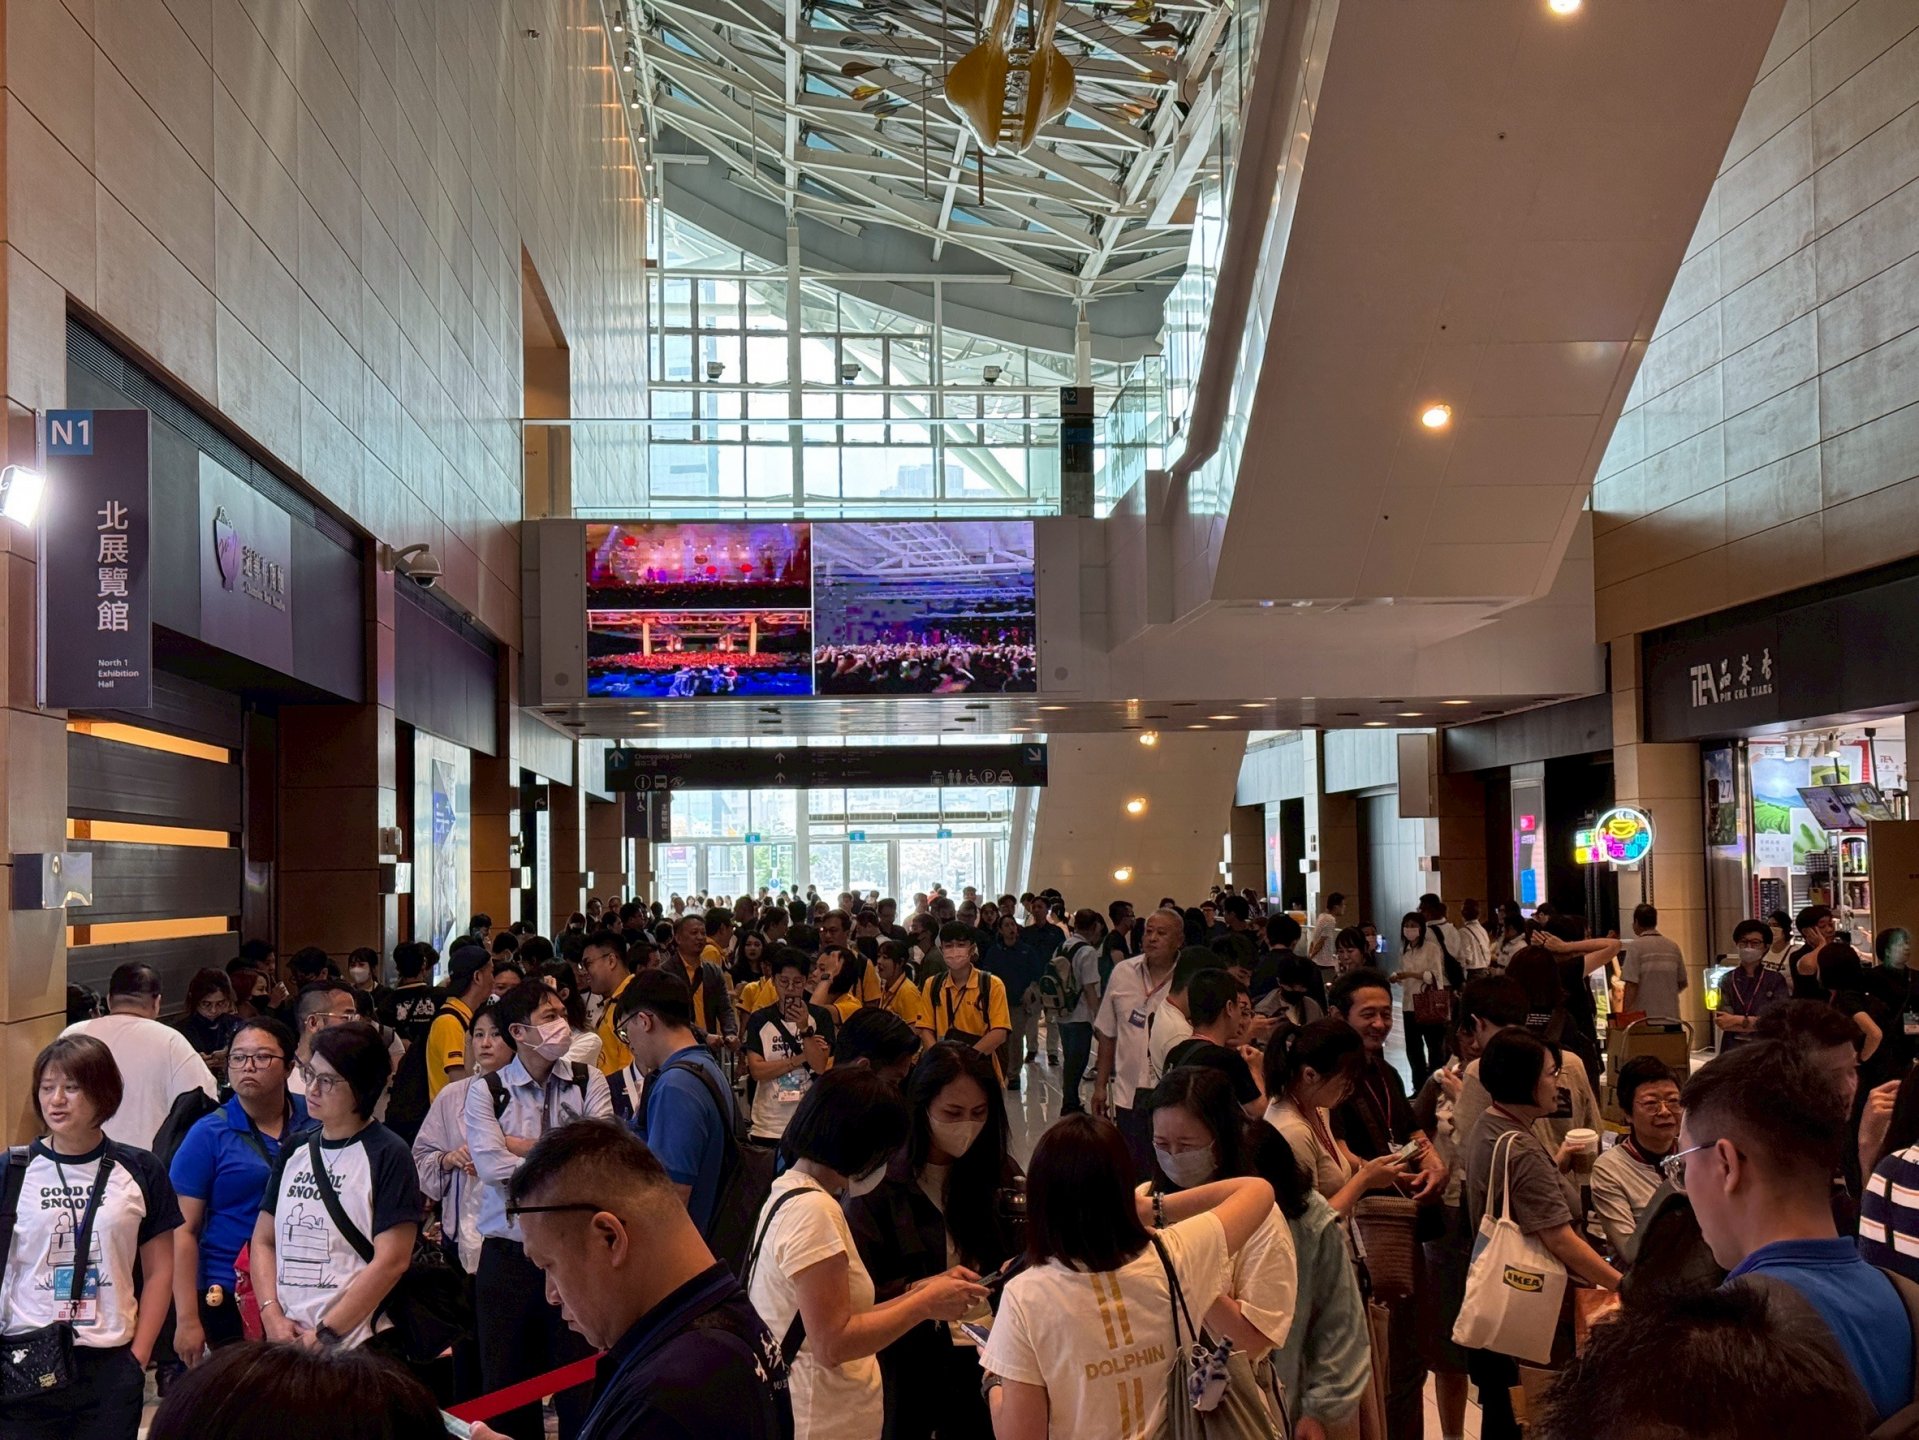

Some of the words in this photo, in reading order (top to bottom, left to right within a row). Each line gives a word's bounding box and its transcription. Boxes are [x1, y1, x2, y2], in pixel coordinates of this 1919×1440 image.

[51, 419, 89, 446] N1
[97, 500, 129, 632] 北展覽館
[98, 658, 122, 667] North
[123, 658, 128, 667] 1
[98, 669, 140, 678] Exhibition
[97, 680, 115, 689] Hall
[293, 1171, 317, 1185] GOO
[40, 1186, 84, 1198] GOOD
[40, 1196, 107, 1210] SNOO
[1507, 1271, 1540, 1287] IKEA
[1084, 1343, 1167, 1381] DOLPHIN
